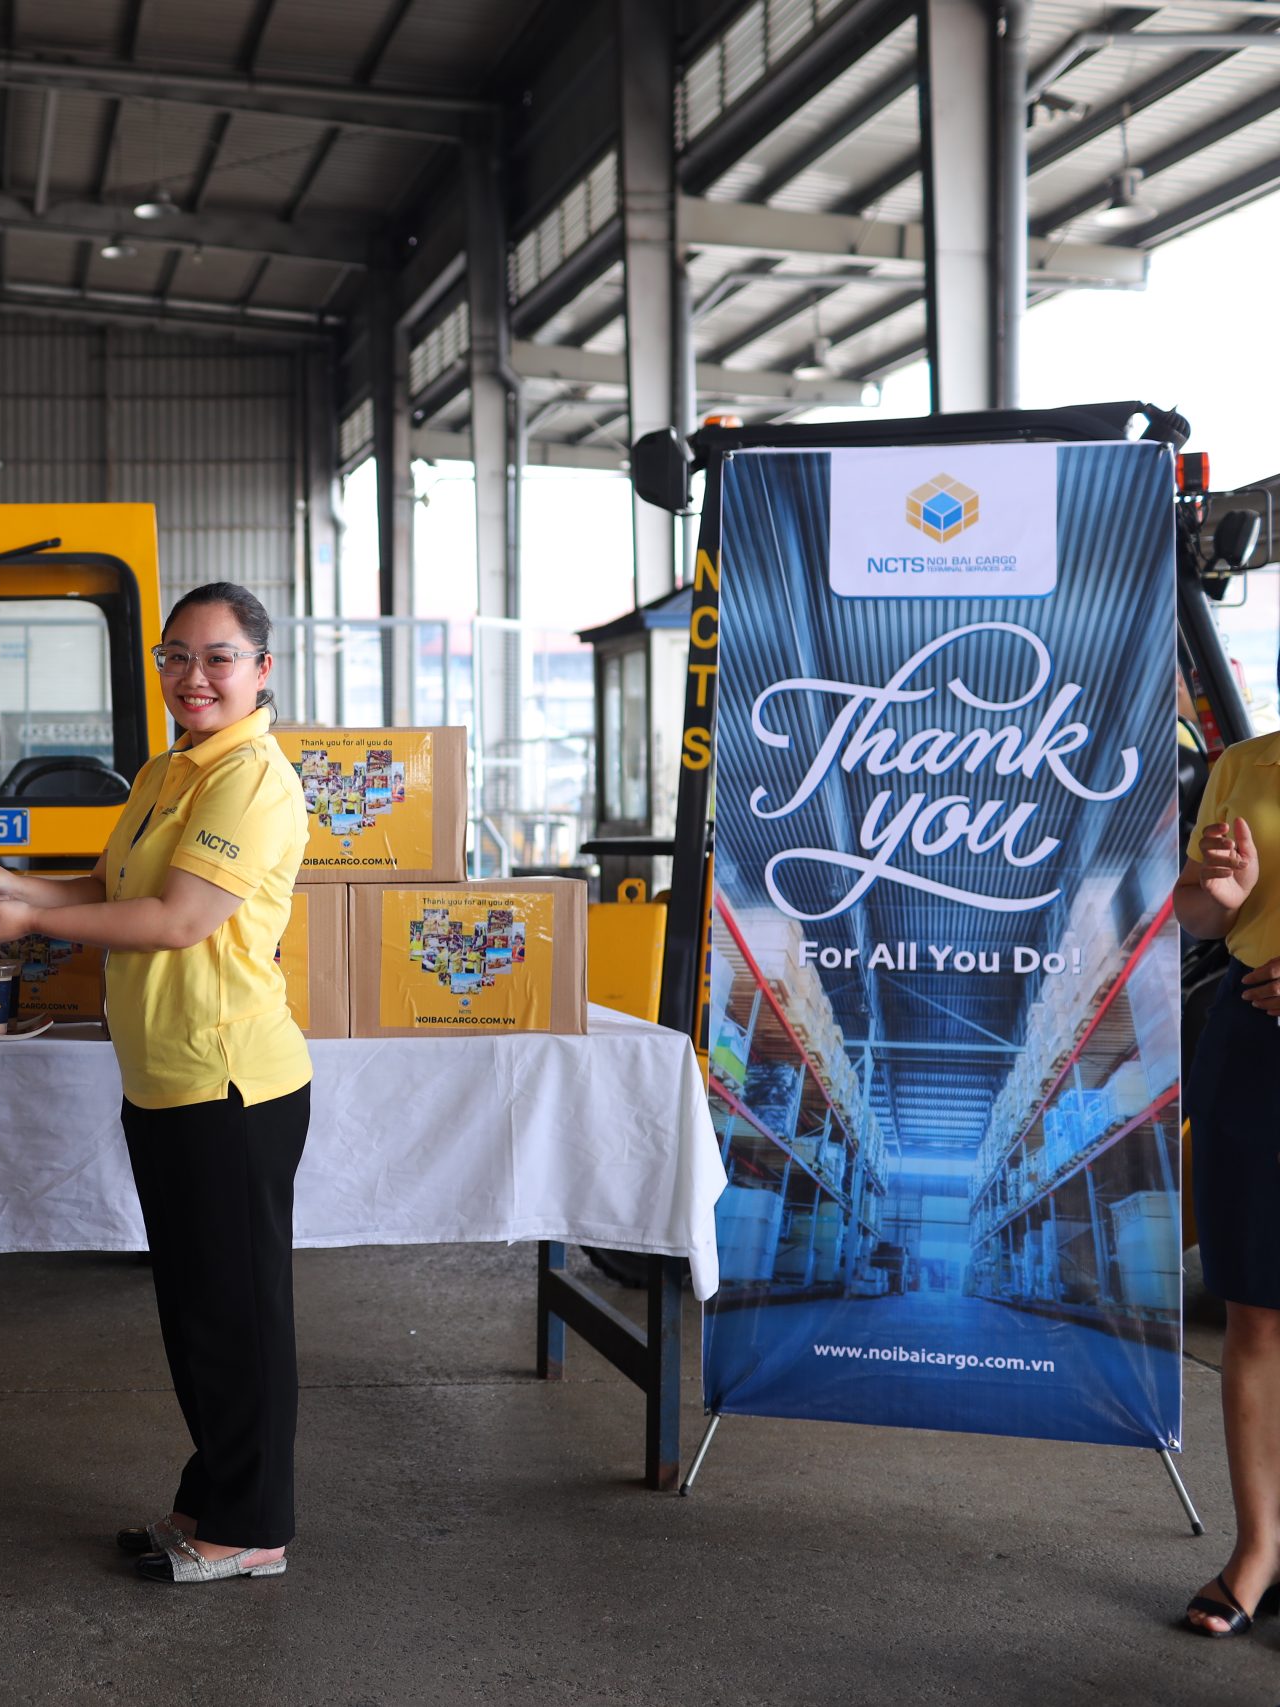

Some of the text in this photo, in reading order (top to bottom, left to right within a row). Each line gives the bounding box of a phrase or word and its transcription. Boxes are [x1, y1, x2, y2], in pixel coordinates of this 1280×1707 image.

[867, 557, 925, 574] NCTS
[926, 555, 1017, 566] NOI BAI CARGO
[965, 565, 1000, 573] SERVICES
[681, 548, 720, 771] NCTS
[749, 621, 1140, 820] Thank
[326, 740, 341, 748] you
[366, 740, 381, 748] you
[196, 829, 240, 859] NCTS
[300, 858, 398, 866] OIBAICARGO.COM.VN
[764, 790, 1063, 922] you
[447, 899, 462, 907] you
[464, 898, 475, 906] for
[488, 899, 503, 907] you
[799, 941, 1082, 975] For All You Do!
[19, 1002, 79, 1010] CARGO.COM.VN
[415, 1016, 516, 1025] NOIBAICARGO.COM.VN
[814, 1344, 1056, 1373] www.noibaicargo.com.vn
